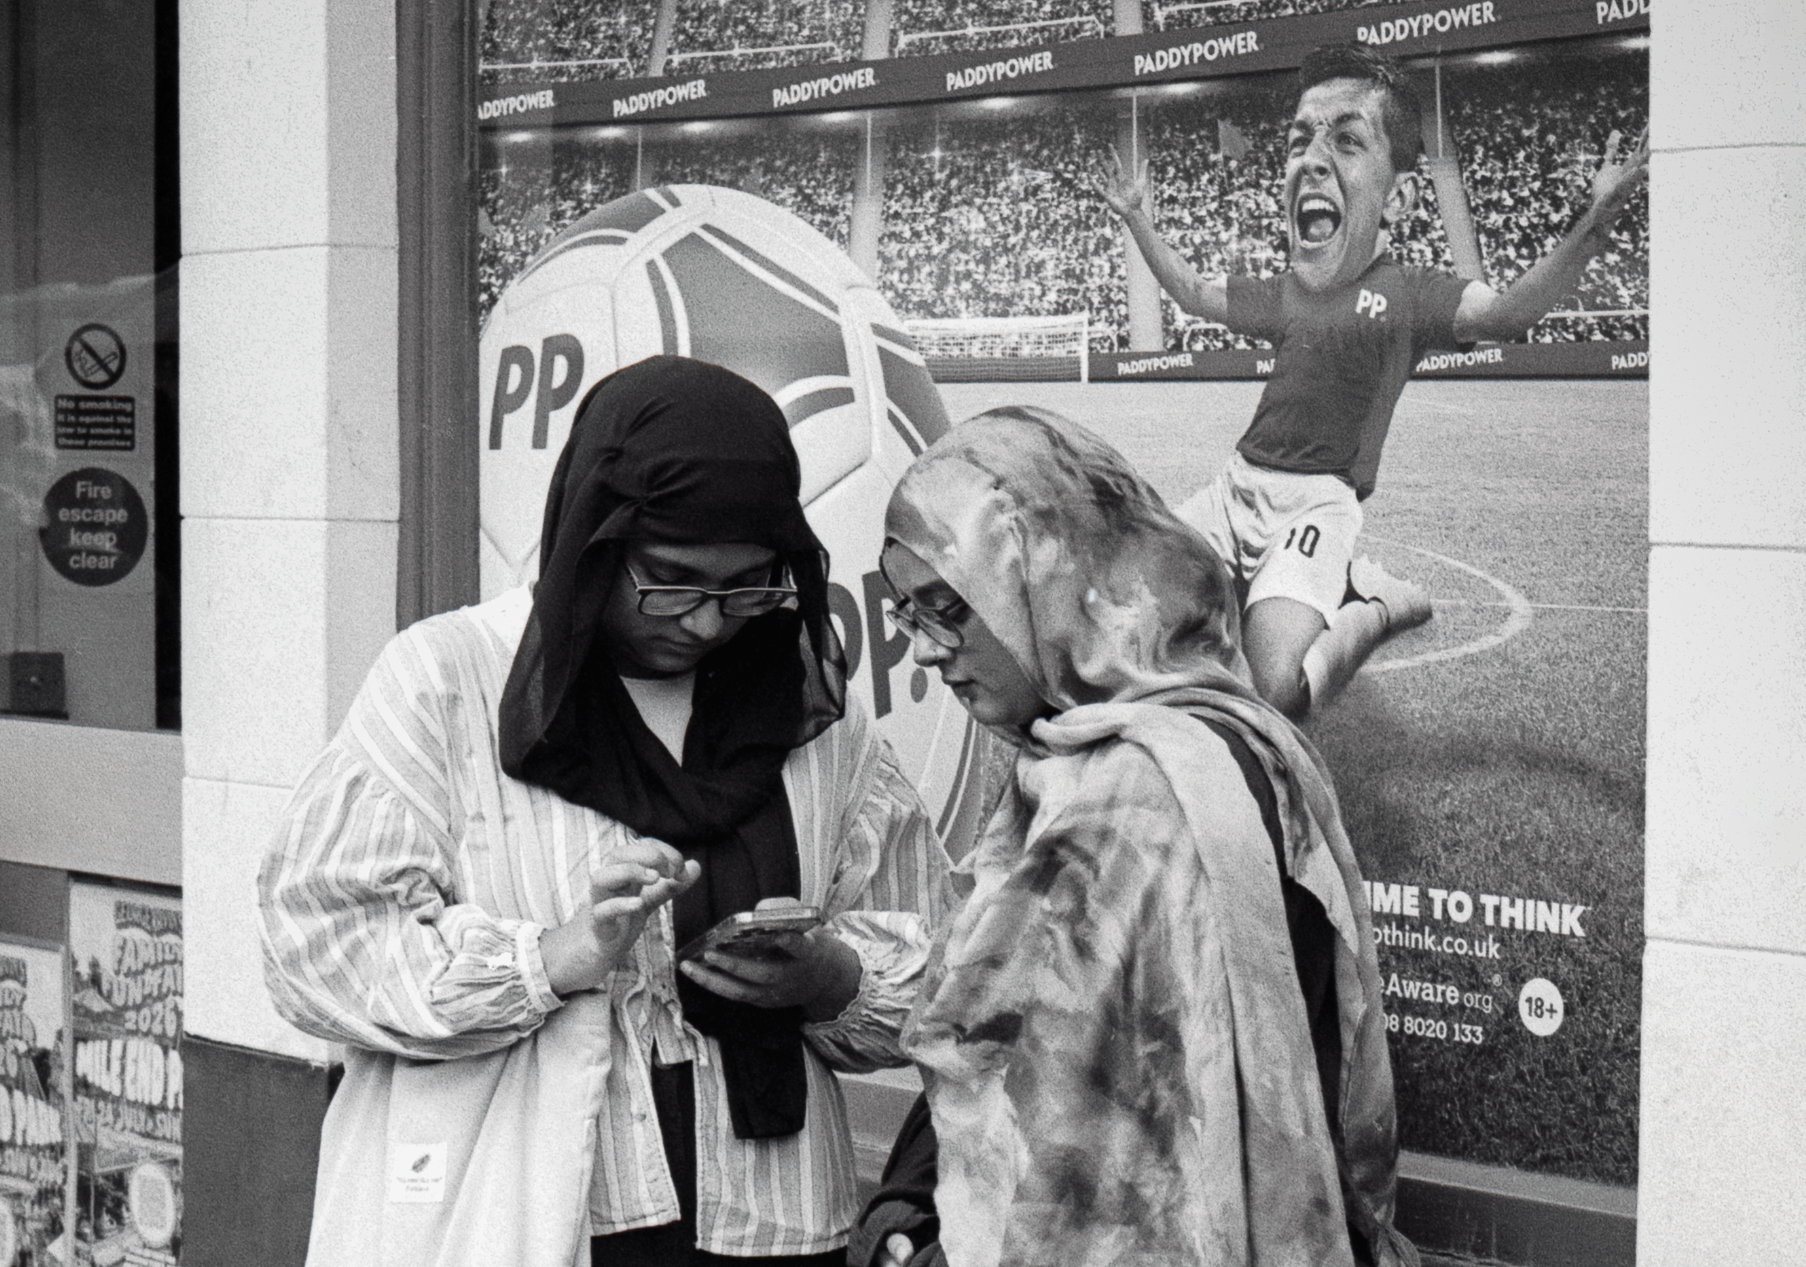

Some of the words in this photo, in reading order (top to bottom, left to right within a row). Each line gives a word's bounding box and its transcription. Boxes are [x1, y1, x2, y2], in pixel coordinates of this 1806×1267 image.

[613, 79, 707, 118] PADDYPOWER
[772, 67, 876, 108] PADDYPOWER
[946, 51, 1054, 91] PADDYPOWER
[1134, 31, 1260, 76] PADDYPOWER
[1357, 1, 1496, 46] PADDYPOWER
[1355, 288, 1388, 319] PP
[1117, 353, 1194, 376] PADDYPOWER
[1611, 351, 1650, 370] PADD
[489, 332, 585, 450] PP
[75, 481, 112, 500] Fire
[58, 508, 128, 526] escape
[70, 527, 117, 551] keep
[69, 551, 118, 570] clear
[1428, 888, 1473, 923] TO
[1480, 894, 1587, 937] THINK
[1525, 996, 1558, 1019] 18+
[1404, 1016, 1447, 1040] 8020
[1454, 1023, 1483, 1045] 133
